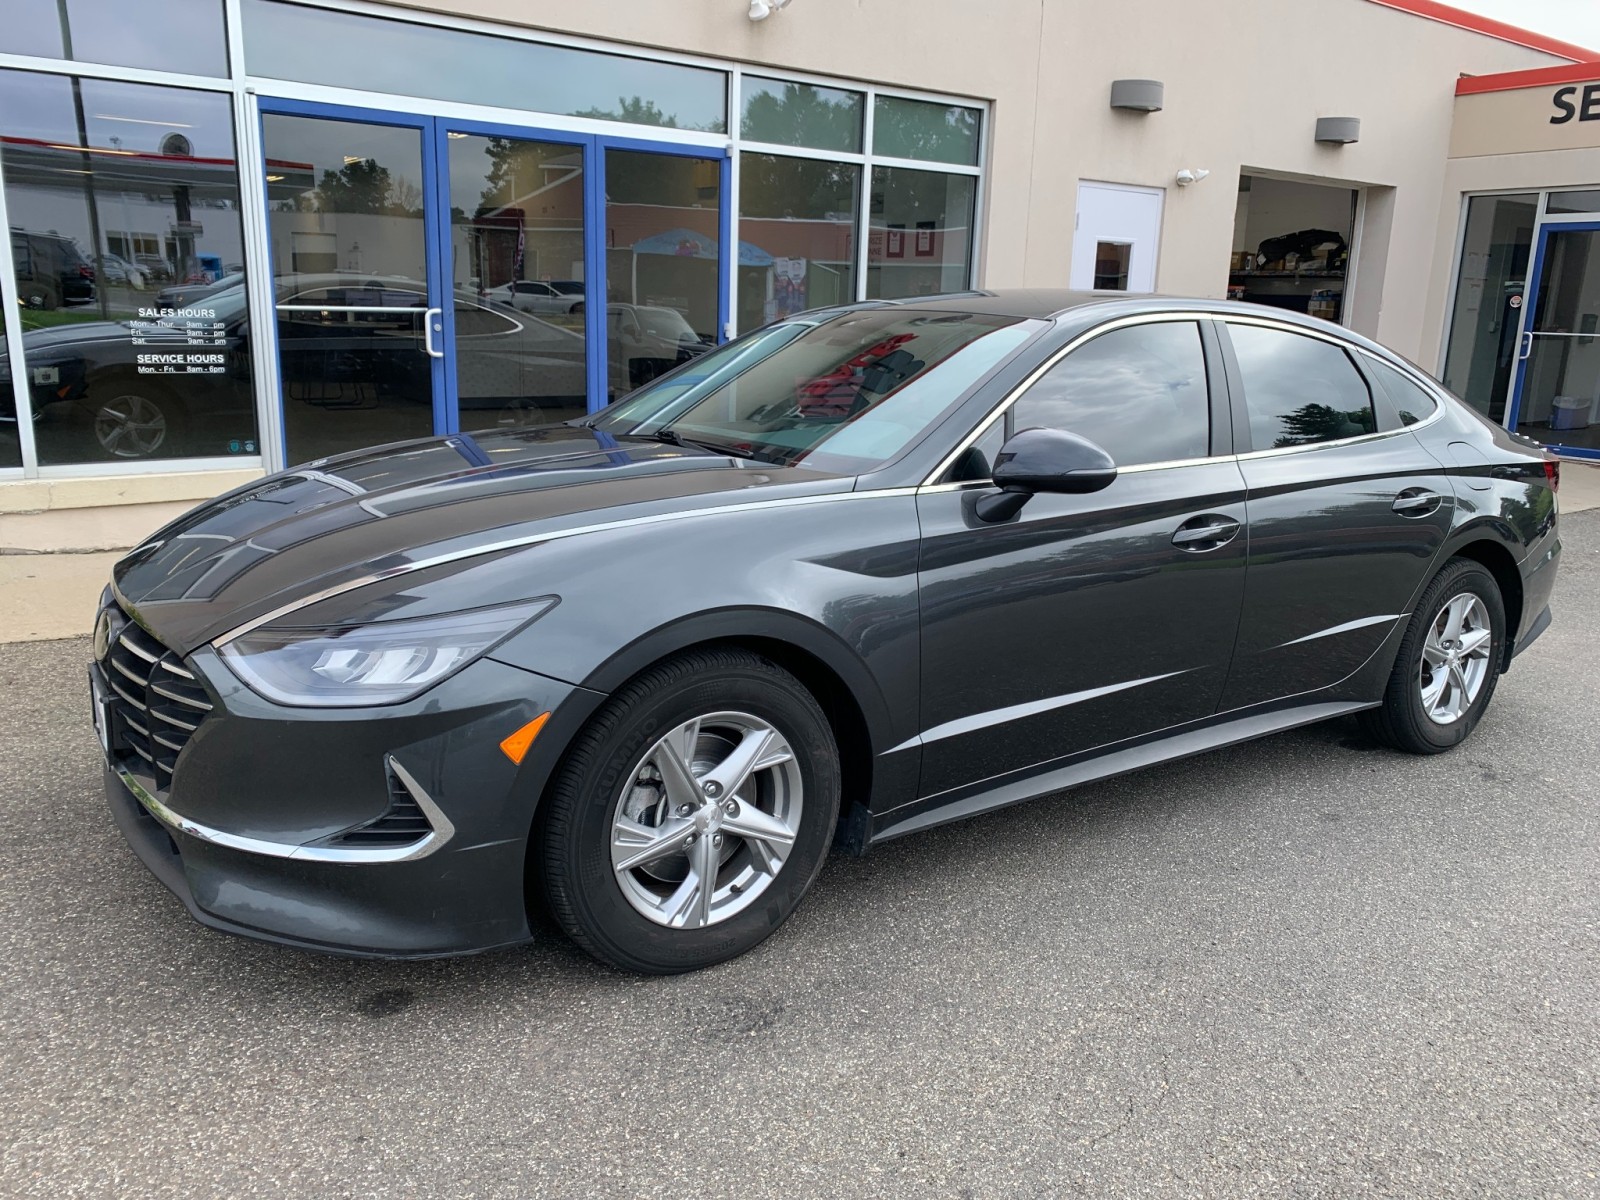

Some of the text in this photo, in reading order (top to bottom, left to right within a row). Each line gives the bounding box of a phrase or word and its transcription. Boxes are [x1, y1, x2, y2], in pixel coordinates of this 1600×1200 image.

[1550, 84, 1600, 124] SE
[138, 307, 216, 318] SALES HOURS
[129, 320, 150, 328] Mon.
[156, 320, 176, 328] Thur.
[186, 320, 203, 328] 9am
[130, 328, 144, 336] Fri.
[131, 337, 147, 345] Sat.
[187, 337, 204, 345] 9am
[137, 354, 225, 363] SERVICE HOURS
[163, 365, 176, 373] Fri.
[186, 365, 203, 373] 8am
[594, 718, 657, 805] KUMHO
